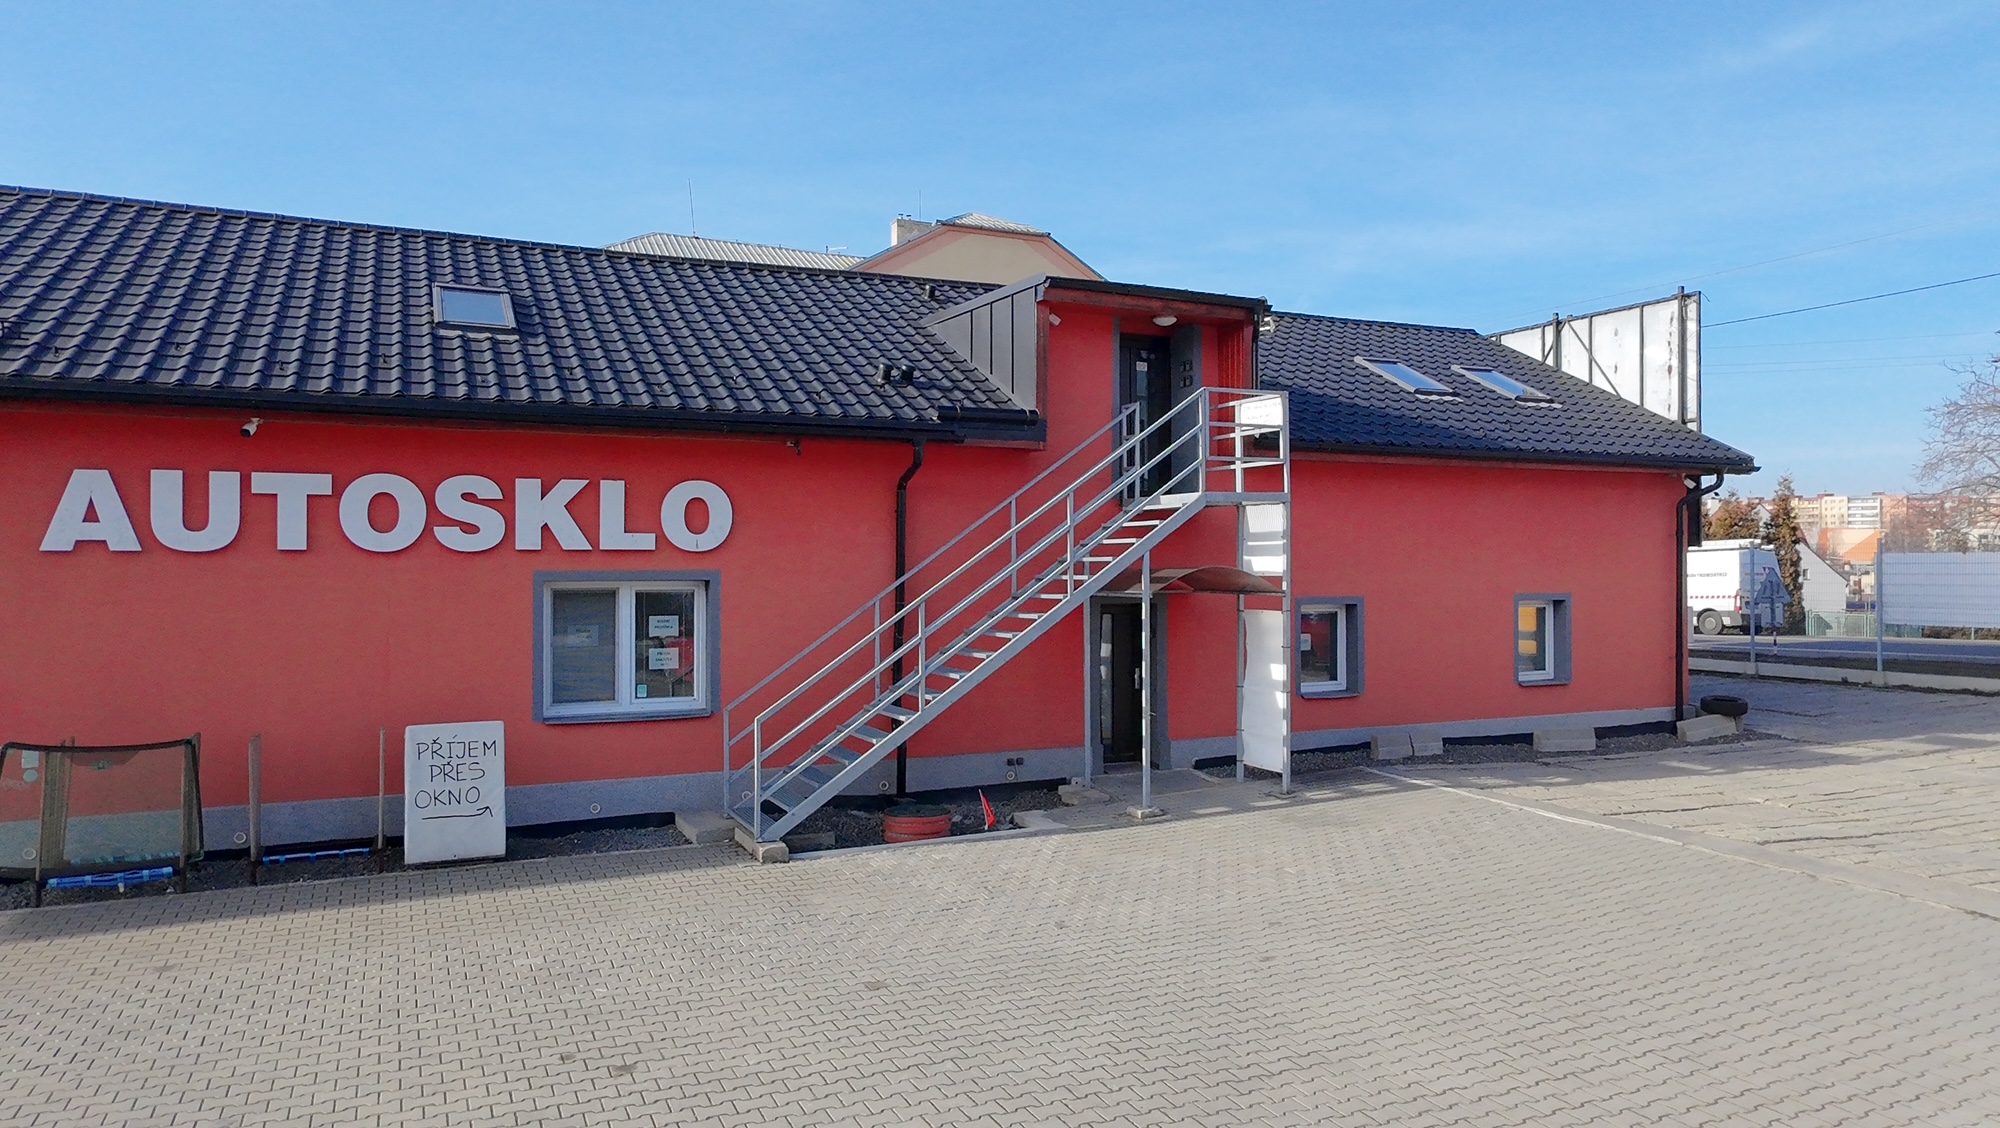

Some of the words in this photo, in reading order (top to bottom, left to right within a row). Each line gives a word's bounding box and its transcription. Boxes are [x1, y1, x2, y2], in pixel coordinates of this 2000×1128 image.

[39, 469, 733, 552] AUTOSKLO
[415, 734, 497, 760] PŘÍJEM
[428, 760, 486, 782] PŘES
[414, 786, 481, 809] OKNO
